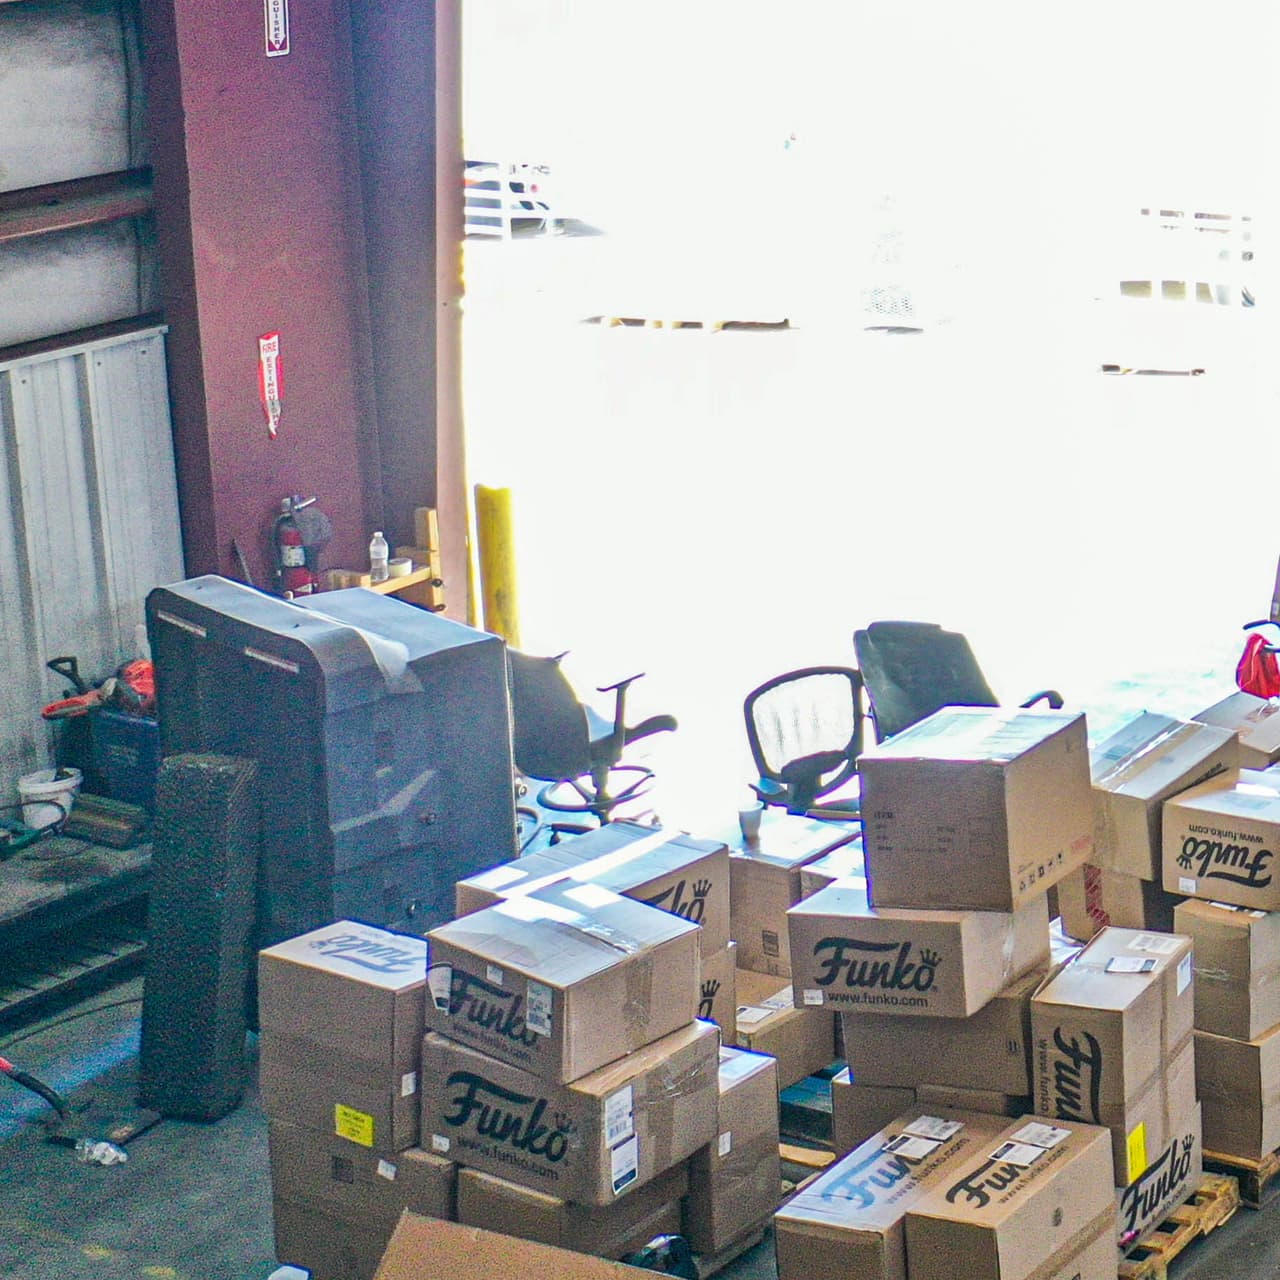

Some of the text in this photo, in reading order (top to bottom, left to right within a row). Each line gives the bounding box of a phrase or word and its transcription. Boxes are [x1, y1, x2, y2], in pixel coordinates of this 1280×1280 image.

[262, 342, 277, 352] FIRE
[1181, 837, 1274, 888] Funko
[813, 937, 935, 992] Funko
[828, 993, 929, 1008] www.funko.com
[1053, 1027, 1102, 1124] Fun
[443, 1071, 568, 1162] Funko
[945, 1156, 1030, 1209] Fun
[1120, 1138, 1191, 1235] Funko
